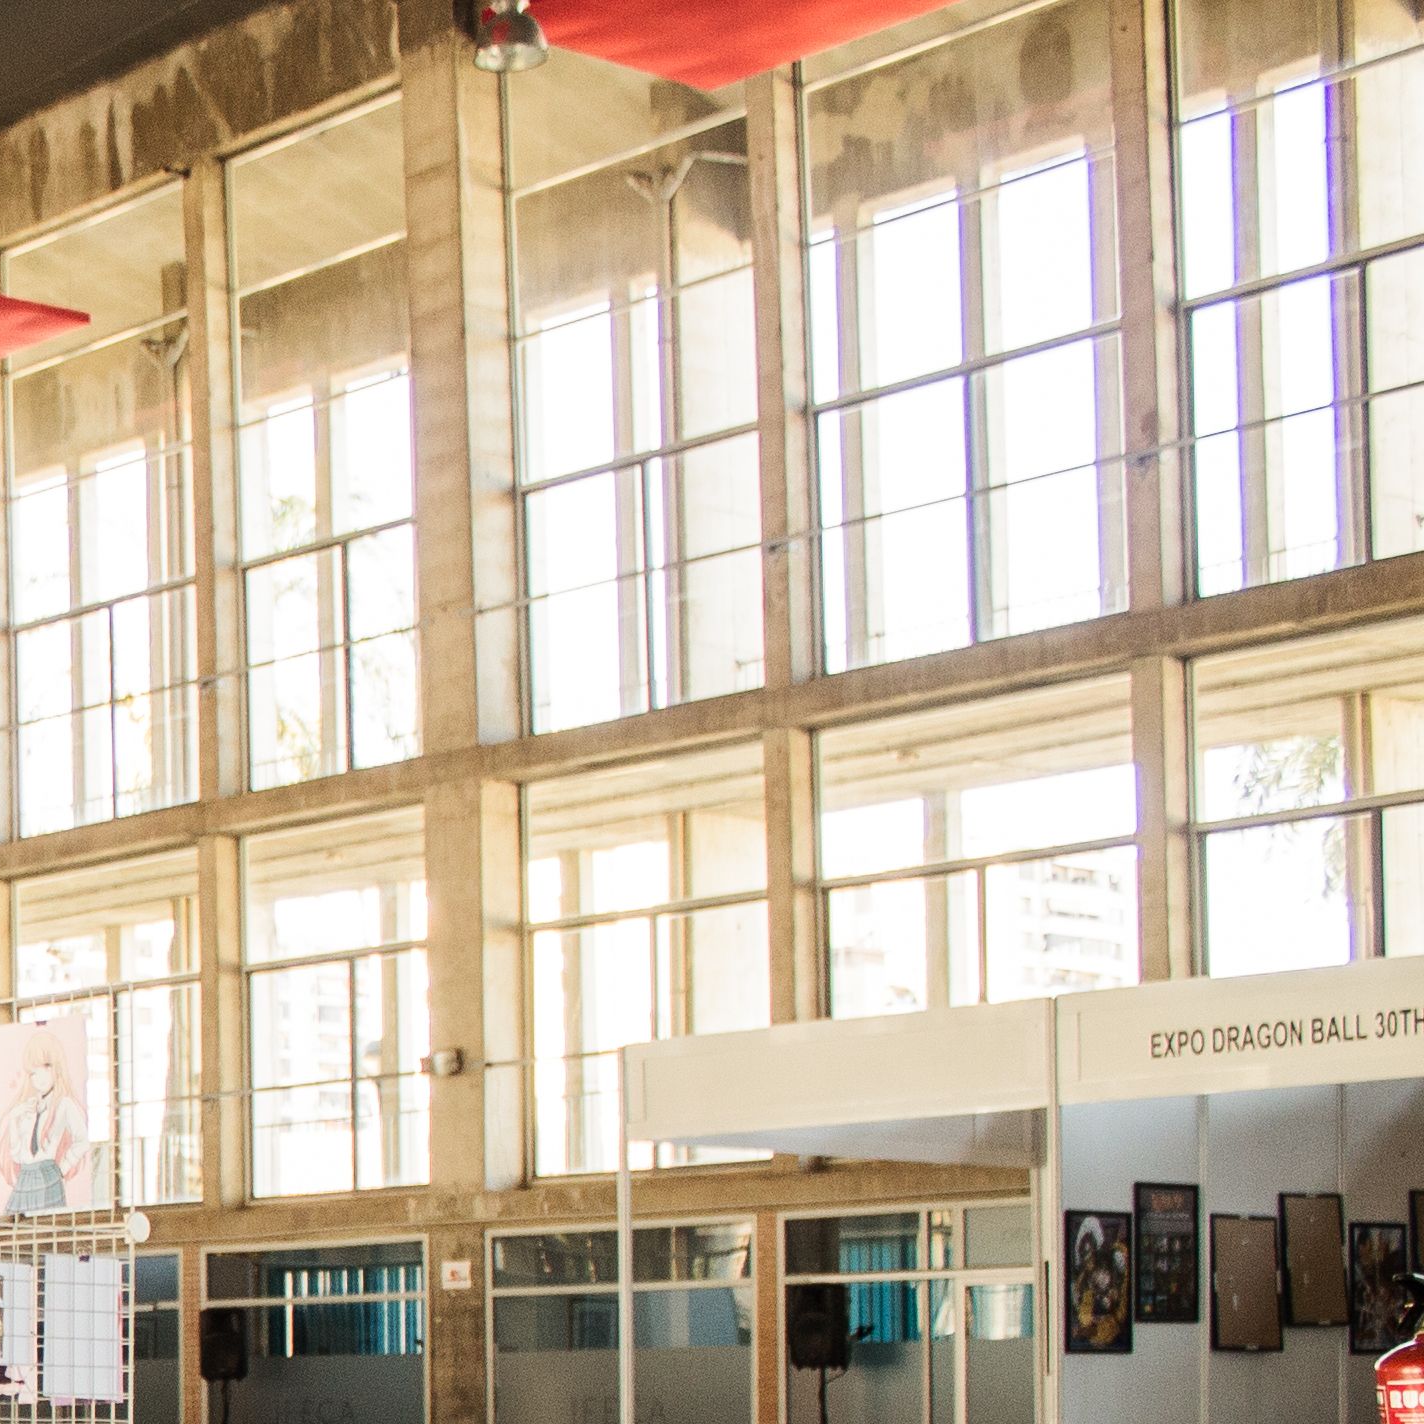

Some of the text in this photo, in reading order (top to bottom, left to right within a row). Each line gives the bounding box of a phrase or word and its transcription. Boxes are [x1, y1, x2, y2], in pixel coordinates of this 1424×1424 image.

[1150, 1008, 1424, 1059] EXPO DRAGON BALL 30TH
